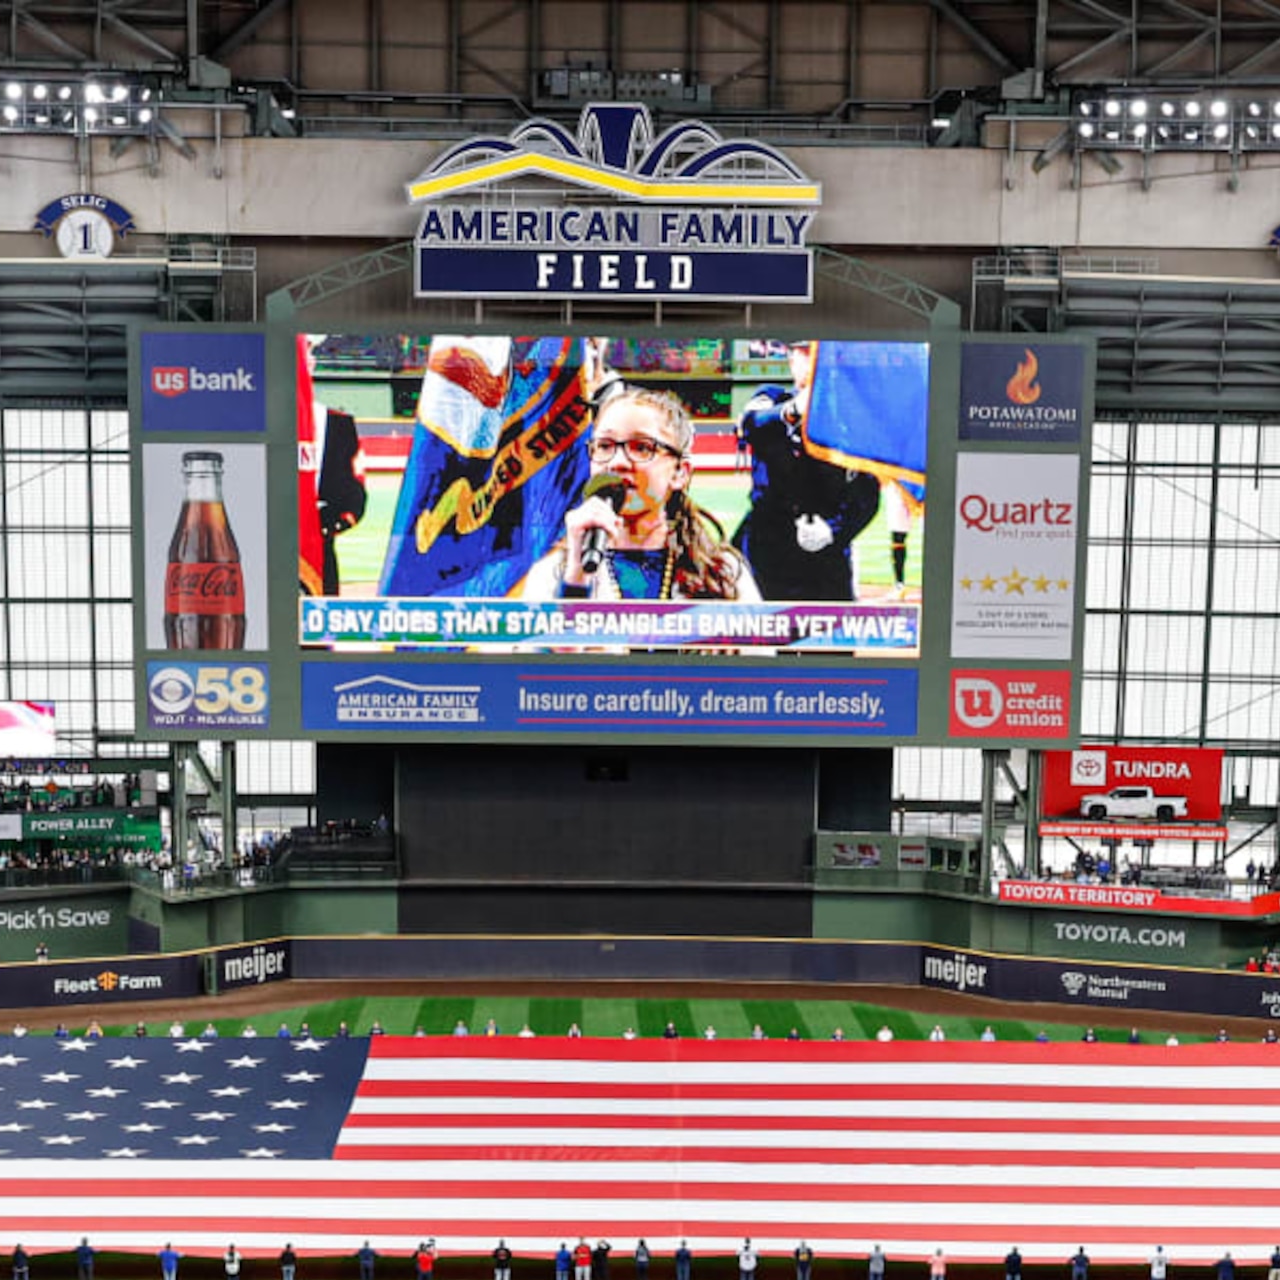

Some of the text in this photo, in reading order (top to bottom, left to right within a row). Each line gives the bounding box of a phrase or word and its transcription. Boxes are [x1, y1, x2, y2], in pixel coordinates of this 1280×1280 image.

[61, 195, 108, 211] SELIG
[77, 222, 93, 251] 1
[421, 208, 810, 246] AMERICAN FAMILY
[536, 253, 694, 291] FIELD
[154, 367, 254, 392] us bank
[968, 406, 1077, 421] POTAWATOMI
[959, 494, 1073, 532] Quartz
[166, 563, 241, 598] Coca-Cola
[308, 609, 913, 641] O SAY DOES THAT STAR-SPANGLED BANNER YET WAVE,
[194, 667, 268, 715] 58
[1006, 681, 1037, 694] uw
[337, 694, 479, 708] AMERICAN FAMILY
[519, 687, 885, 719] Insure carefully, dream fearlessly.
[1006, 695, 1063, 710] credit
[153, 713, 265, 726] WDJT MILWAUKEE
[347, 709, 468, 720] INSURANCE
[1006, 710, 1064, 727] union
[1112, 760, 1192, 779] TUNDRA
[30, 818, 115, 832] POWER ALLEY
[1004, 884, 1156, 906] TOYOTA TERRITORY
[57, 908, 110, 928] Save
[1054, 922, 1186, 948] TOYOTA.COM
[224, 946, 287, 984] meijer
[924, 953, 988, 991] meijer
[54, 975, 162, 994] Fleet Farm
[1087, 986, 1128, 999] Mutual
[1088, 974, 1167, 991] Northwestern
